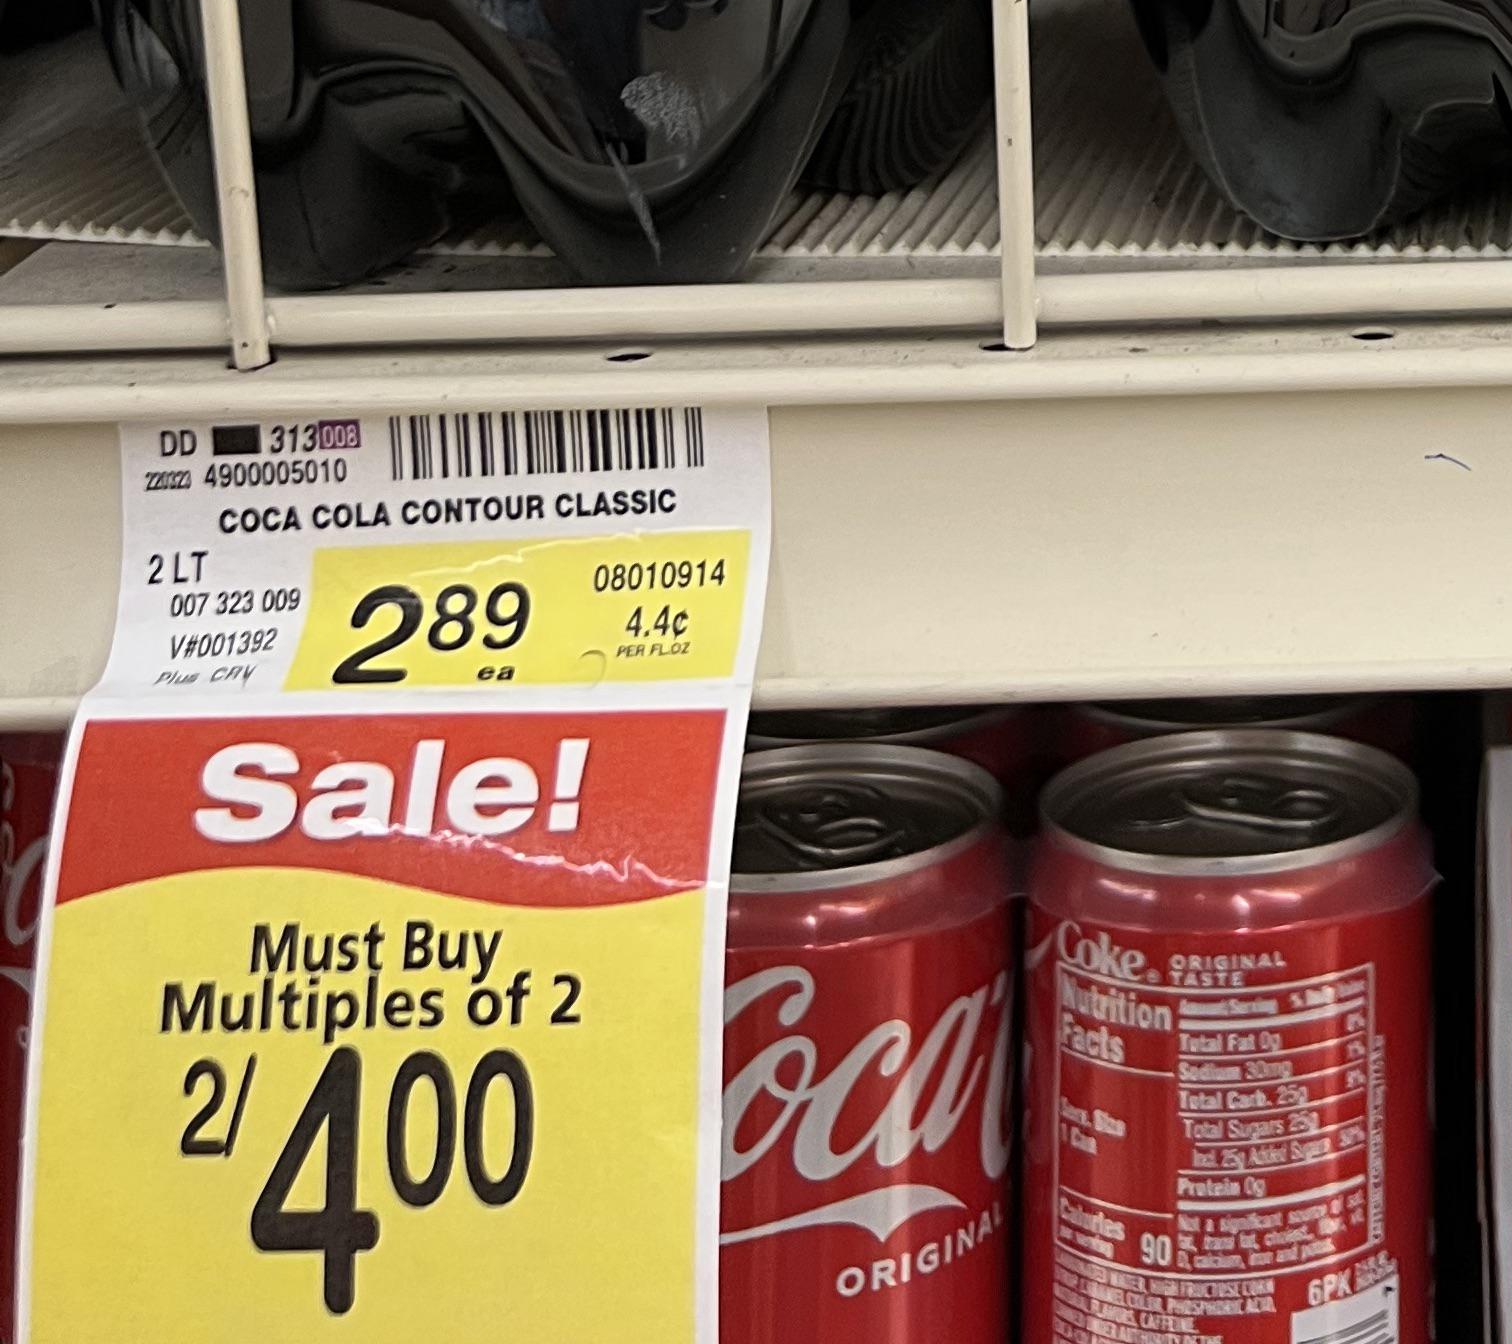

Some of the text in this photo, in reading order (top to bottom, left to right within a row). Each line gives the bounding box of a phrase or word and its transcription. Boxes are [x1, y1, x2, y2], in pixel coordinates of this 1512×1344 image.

[161, 429, 197, 457] DD
[205, 458, 348, 488] 4900005010
[219, 488, 678, 534] COCA COLA CONTOUR CLASSIC
[148, 551, 209, 585] 2 LT
[593, 558, 726, 593] 08010914
[170, 587, 301, 618] 007 323 009
[625, 604, 690, 640] 4.4¢
[171, 628, 279, 660] V#001392
[616, 644, 645, 658] PER
[477, 665, 515, 682] ea
[194, 737, 591, 843] Sale!
[249, 920, 503, 984] Must Buy
[1057, 919, 1287, 981] Coke ORIGINAL
[1168, 970, 1244, 987] TASTE
[160, 970, 583, 1044] Multiples of 2
[1062, 972, 1173, 1032] Nutrition
[1062, 1012, 1126, 1064] Facts
[1140, 1232, 1172, 1266] 90
[1308, 1268, 1353, 1306] 6PK
